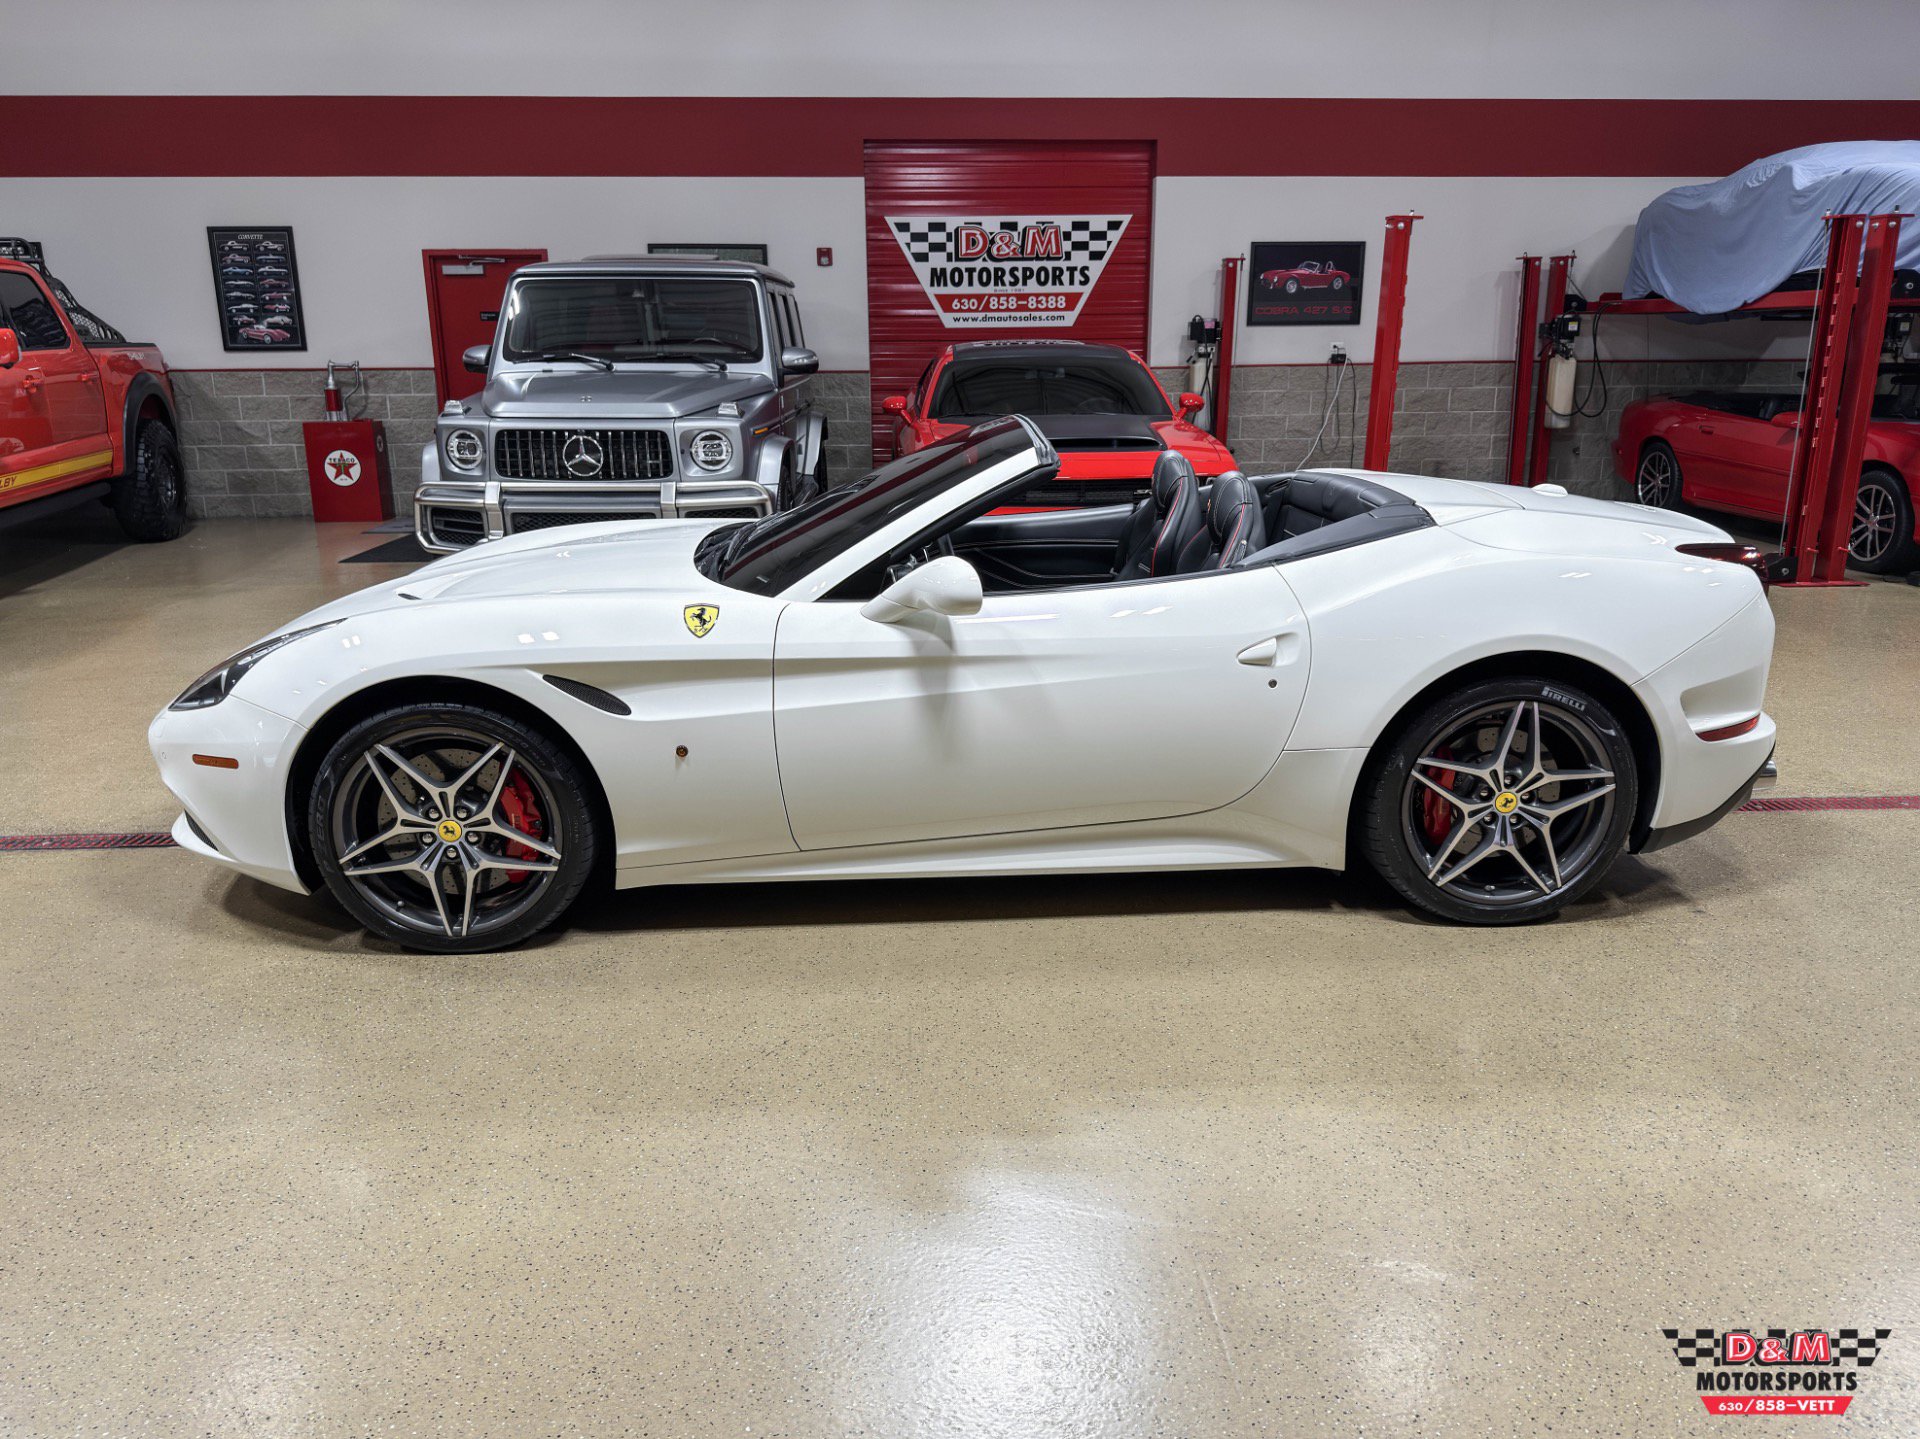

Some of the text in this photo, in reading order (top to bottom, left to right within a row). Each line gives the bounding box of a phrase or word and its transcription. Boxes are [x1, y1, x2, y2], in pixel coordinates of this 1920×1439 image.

[955, 225, 1065, 261] D&M
[929, 265, 1091, 288] MOTORSPORTS
[951, 296, 1067, 312] 630/858-8388
[1255, 306, 1299, 315] COBRA
[1303, 306, 1329, 315] 427
[953, 313, 1066, 324] www.dmautosales.com
[1541, 686, 1588, 712] PIRELLI
